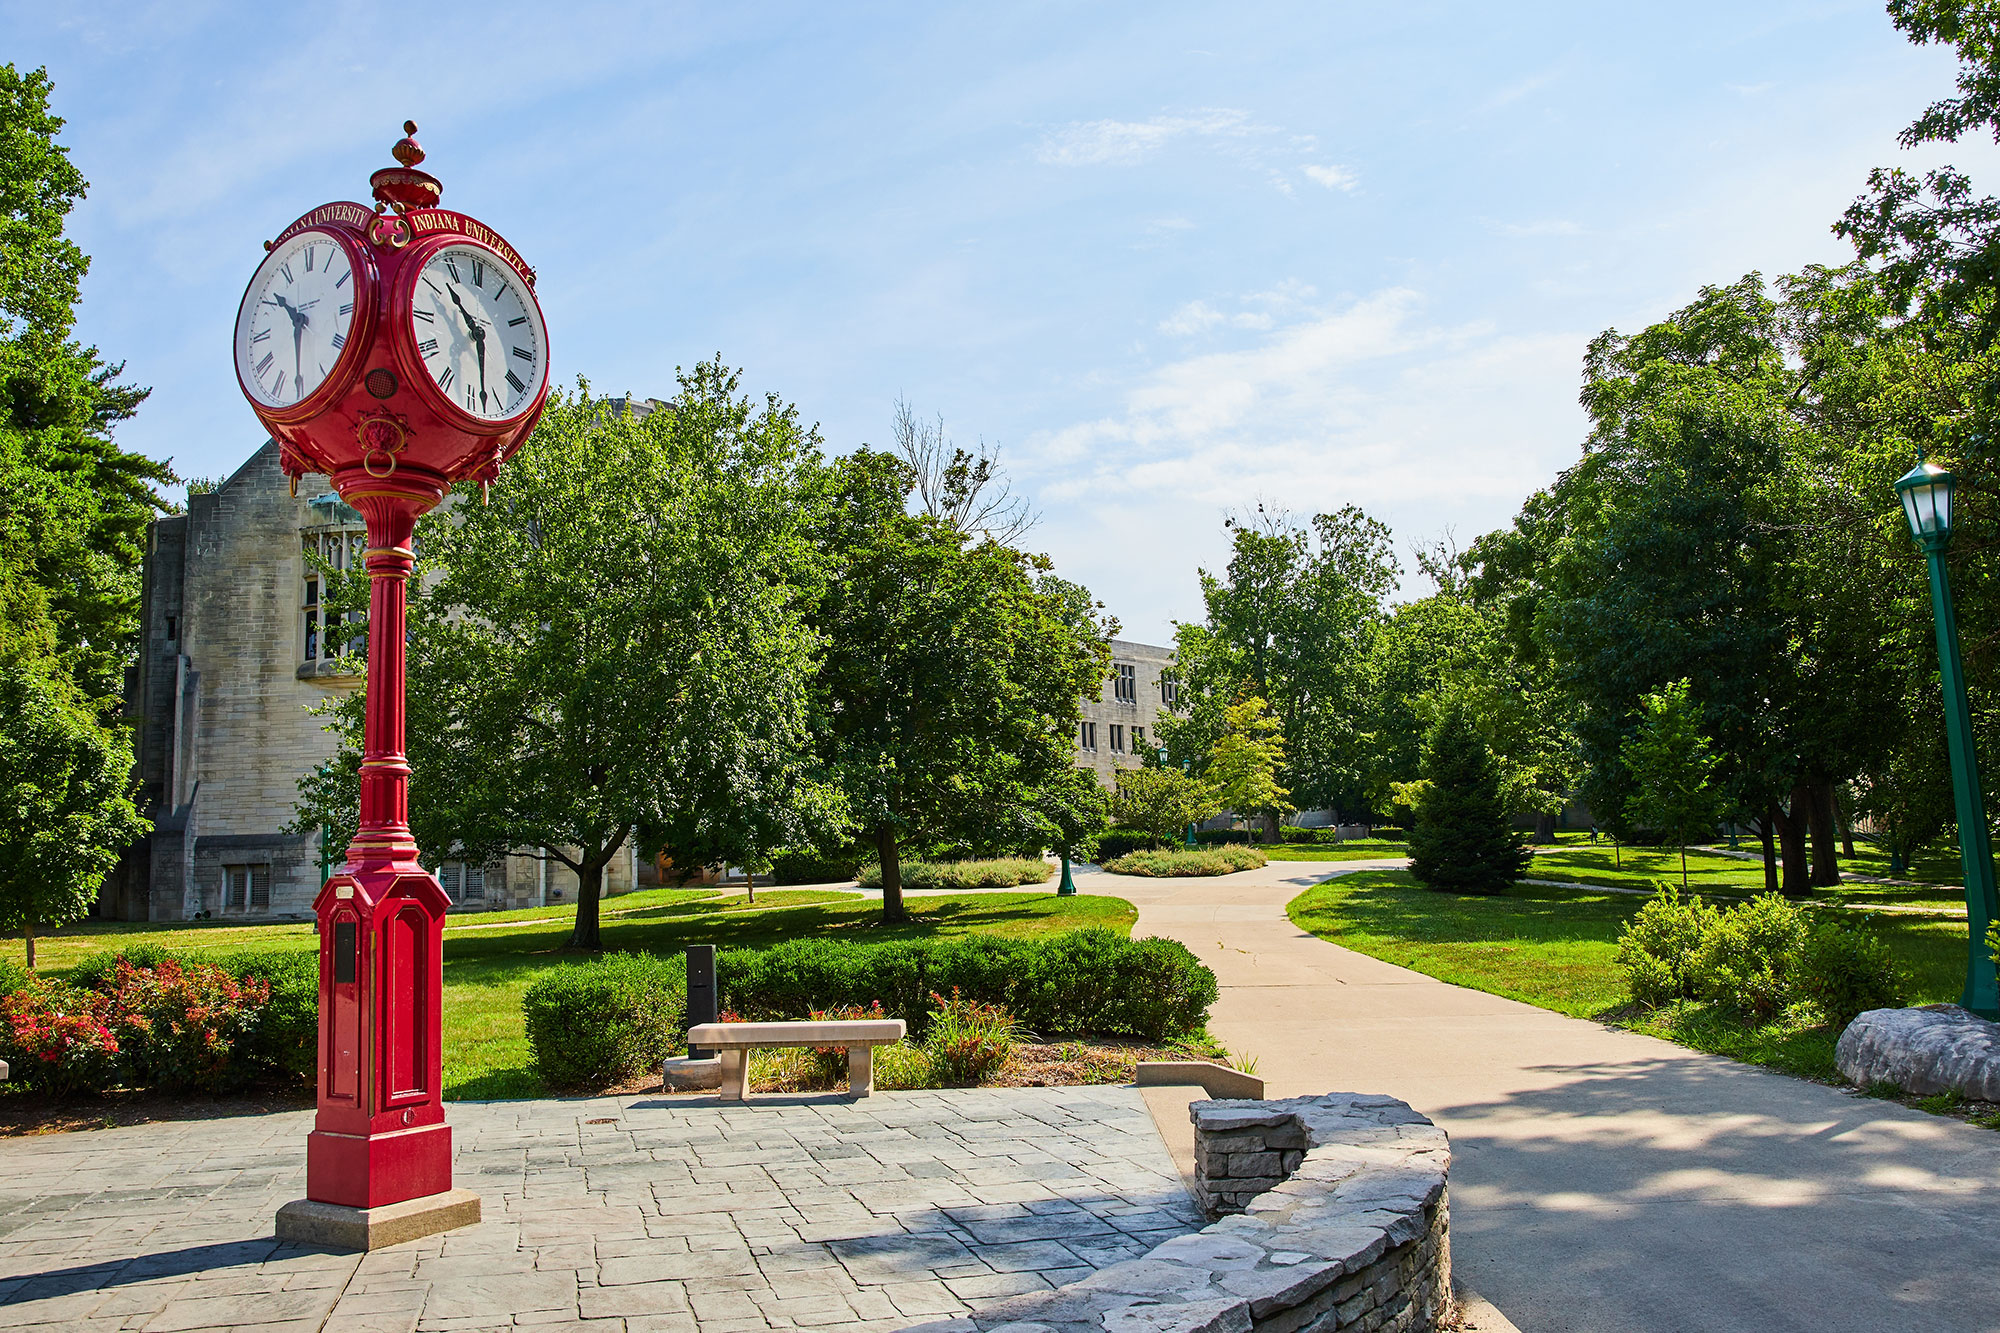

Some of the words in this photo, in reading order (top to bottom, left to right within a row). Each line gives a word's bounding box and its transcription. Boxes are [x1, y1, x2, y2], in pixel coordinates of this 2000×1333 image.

[315, 205, 367, 227] UNIVERSITY
[412, 213, 460, 232] INDIANA
[465, 219, 526, 271] UNIVERSITY
